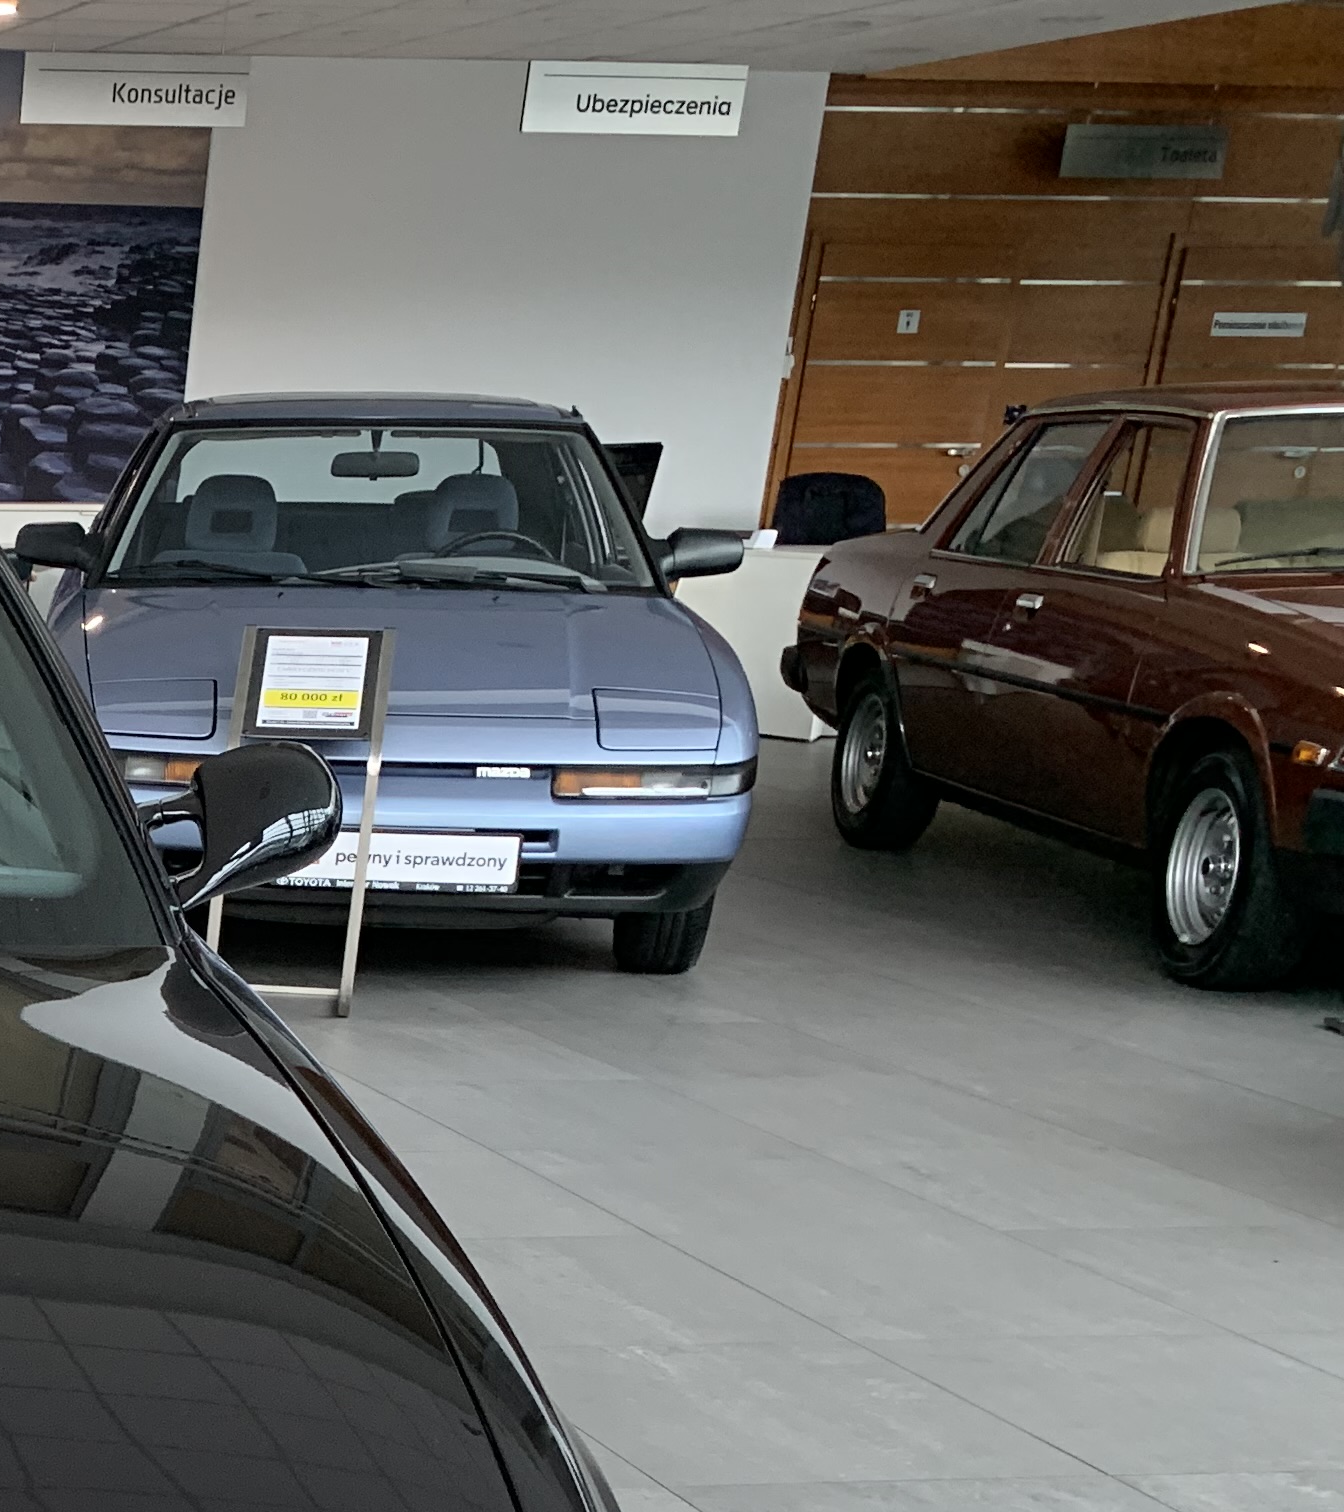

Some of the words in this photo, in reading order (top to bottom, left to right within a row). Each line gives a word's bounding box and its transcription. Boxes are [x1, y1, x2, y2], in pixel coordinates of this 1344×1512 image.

[112, 82, 236, 110] Konsultacje
[576, 93, 731, 117] Ubezpieczenia
[280, 692, 298, 701] 80
[301, 693, 328, 702] 000
[335, 850, 392, 868] peny
[395, 850, 401, 864] i
[404, 852, 508, 871] sprawdzony
[289, 877, 332, 888] TOYOTA
